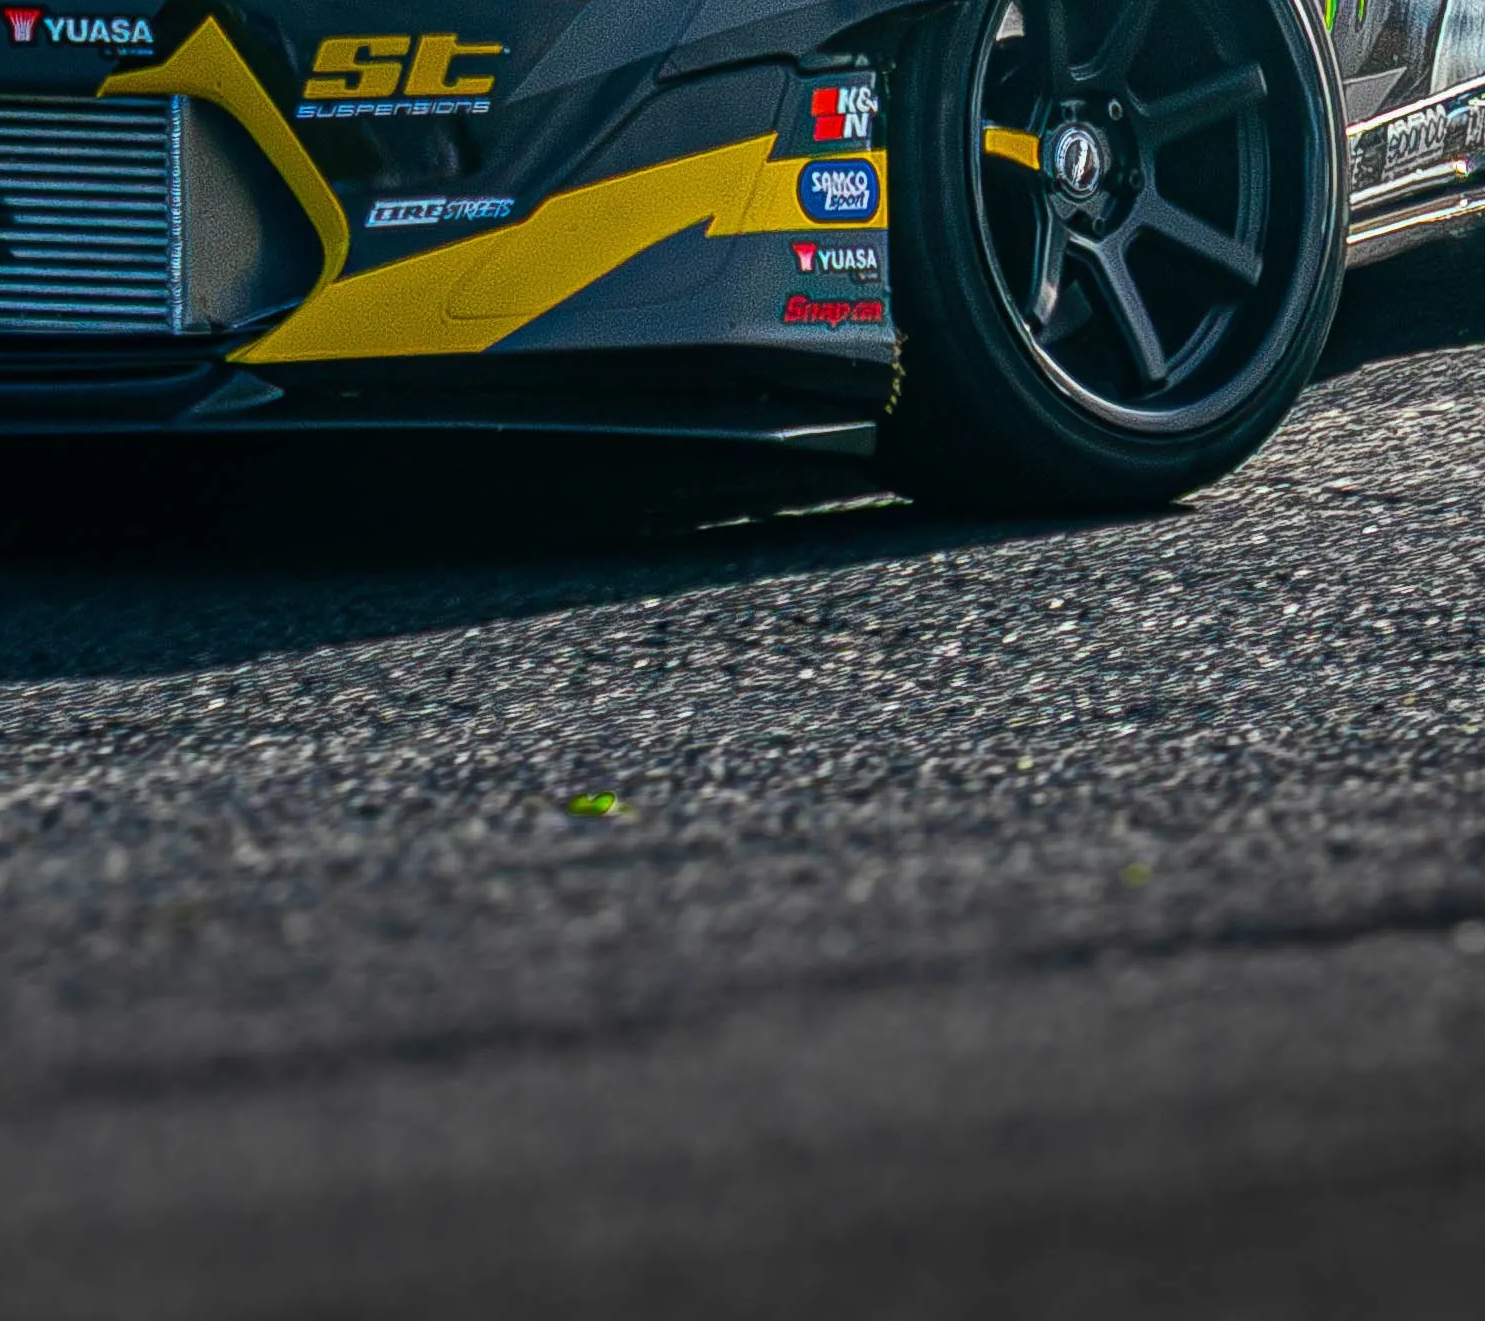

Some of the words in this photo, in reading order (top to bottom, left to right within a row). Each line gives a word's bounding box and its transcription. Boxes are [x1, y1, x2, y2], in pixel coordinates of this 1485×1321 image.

[44, 18, 154, 44] YUASA
[296, 98, 491, 119] SUSPENSIONS
[811, 170, 868, 195] SAMCO
[443, 197, 515, 221] STREETS
[817, 249, 878, 270] YUASA
